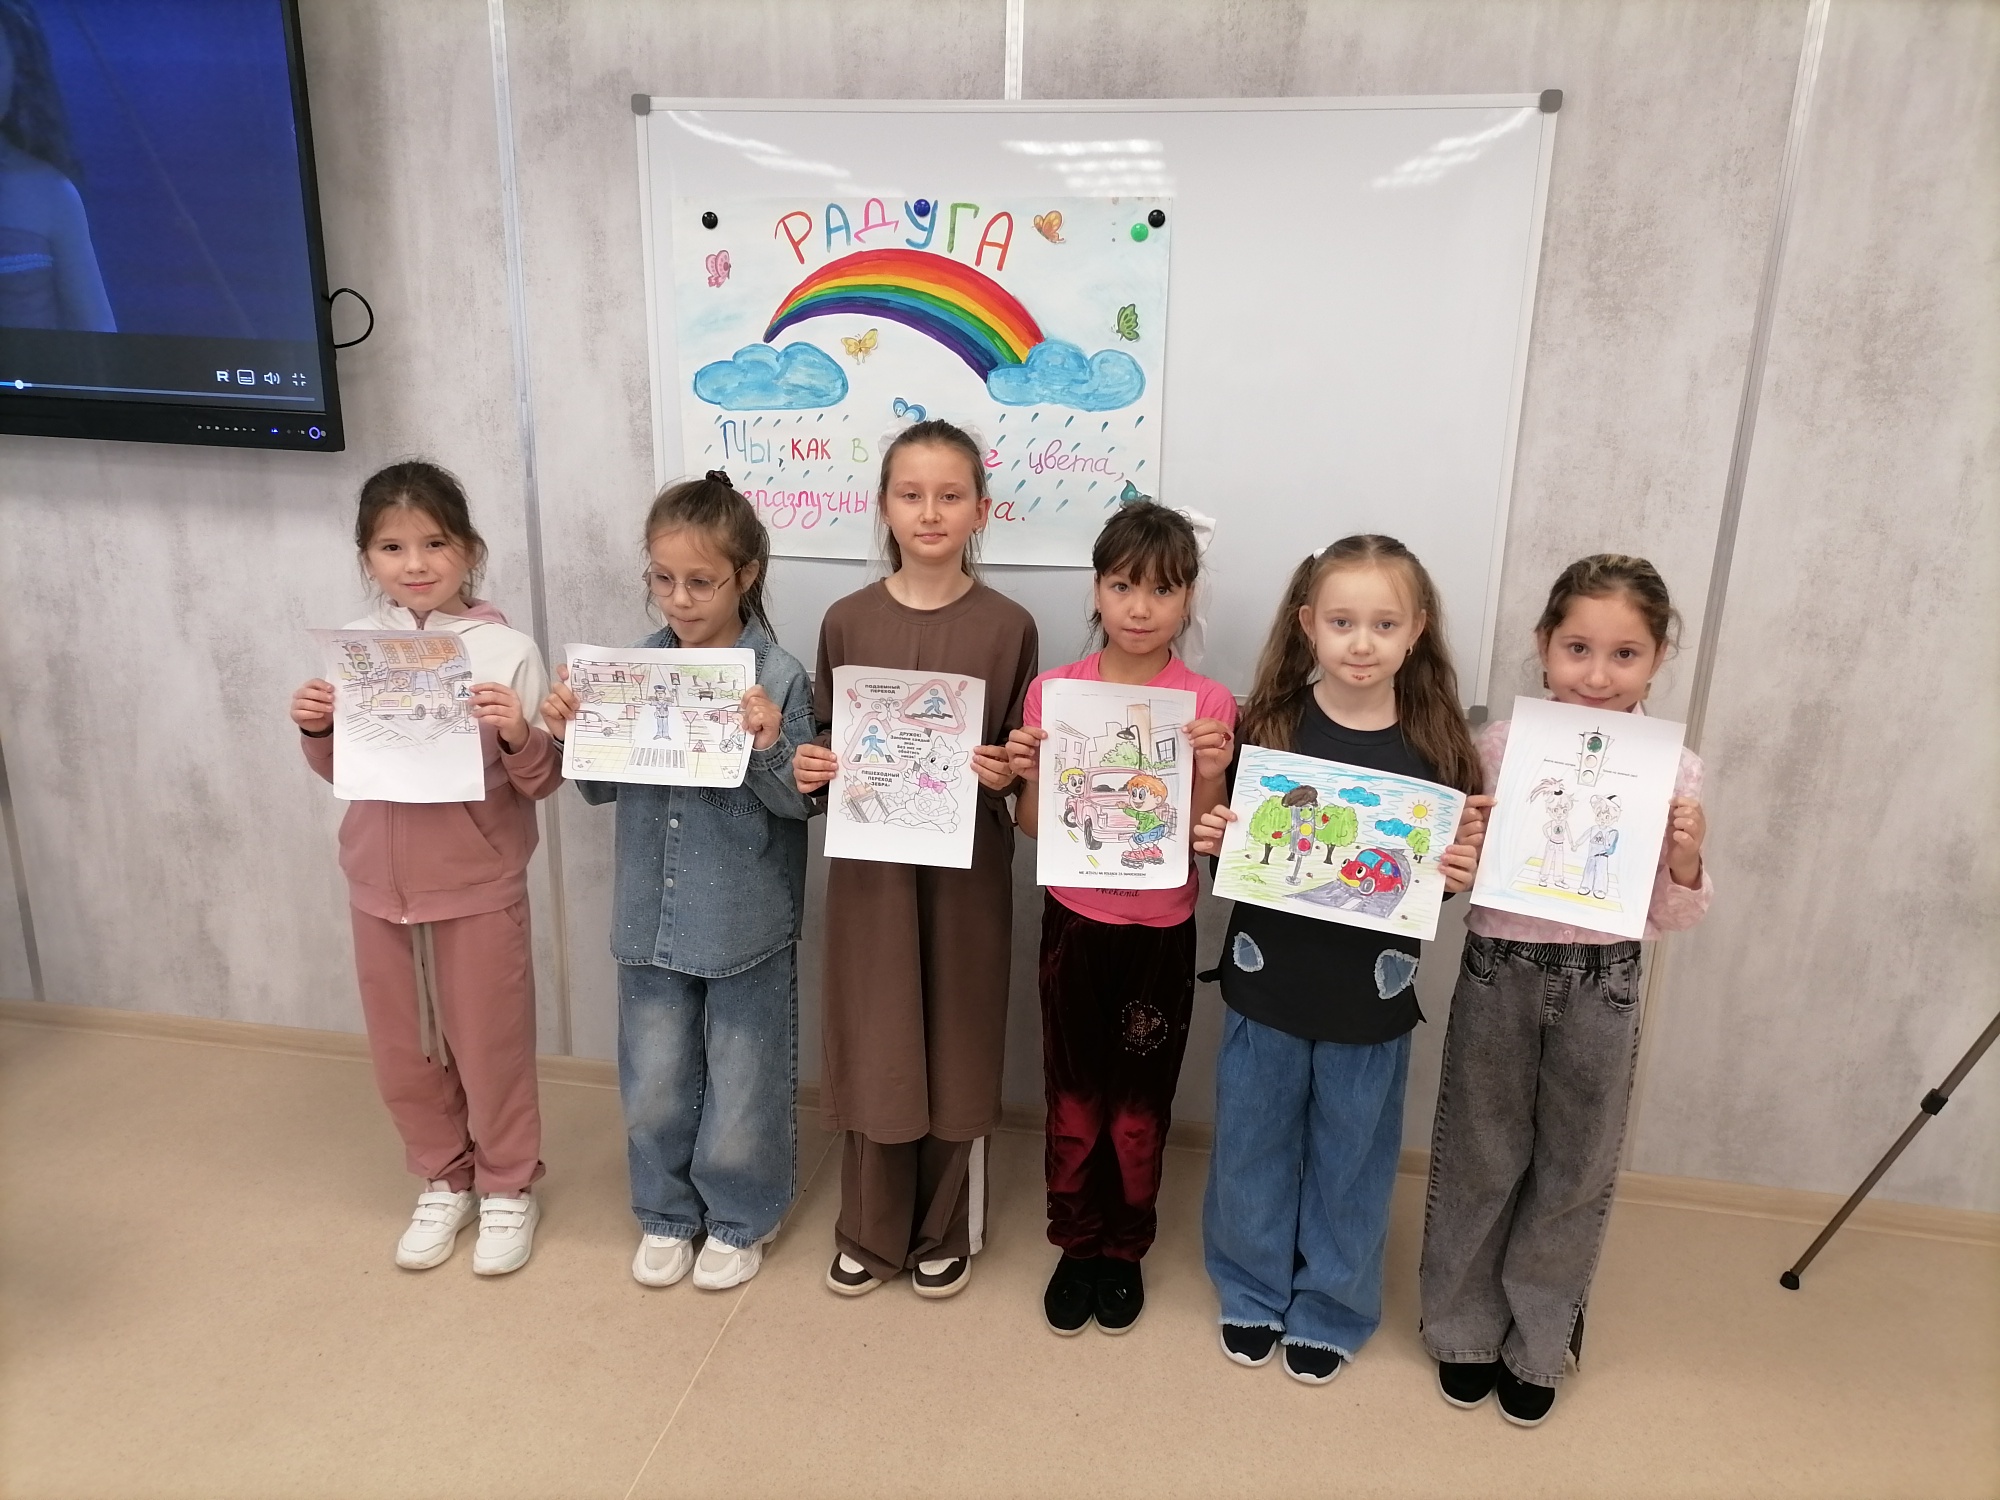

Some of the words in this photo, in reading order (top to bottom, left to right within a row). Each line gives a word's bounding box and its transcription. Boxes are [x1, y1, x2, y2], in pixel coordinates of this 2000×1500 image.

[774, 197, 1014, 271] РАДУГА
[1028, 439, 1125, 483] цвета,
[861, 770, 900, 778] ПЕШЕХОДНЫЙ
